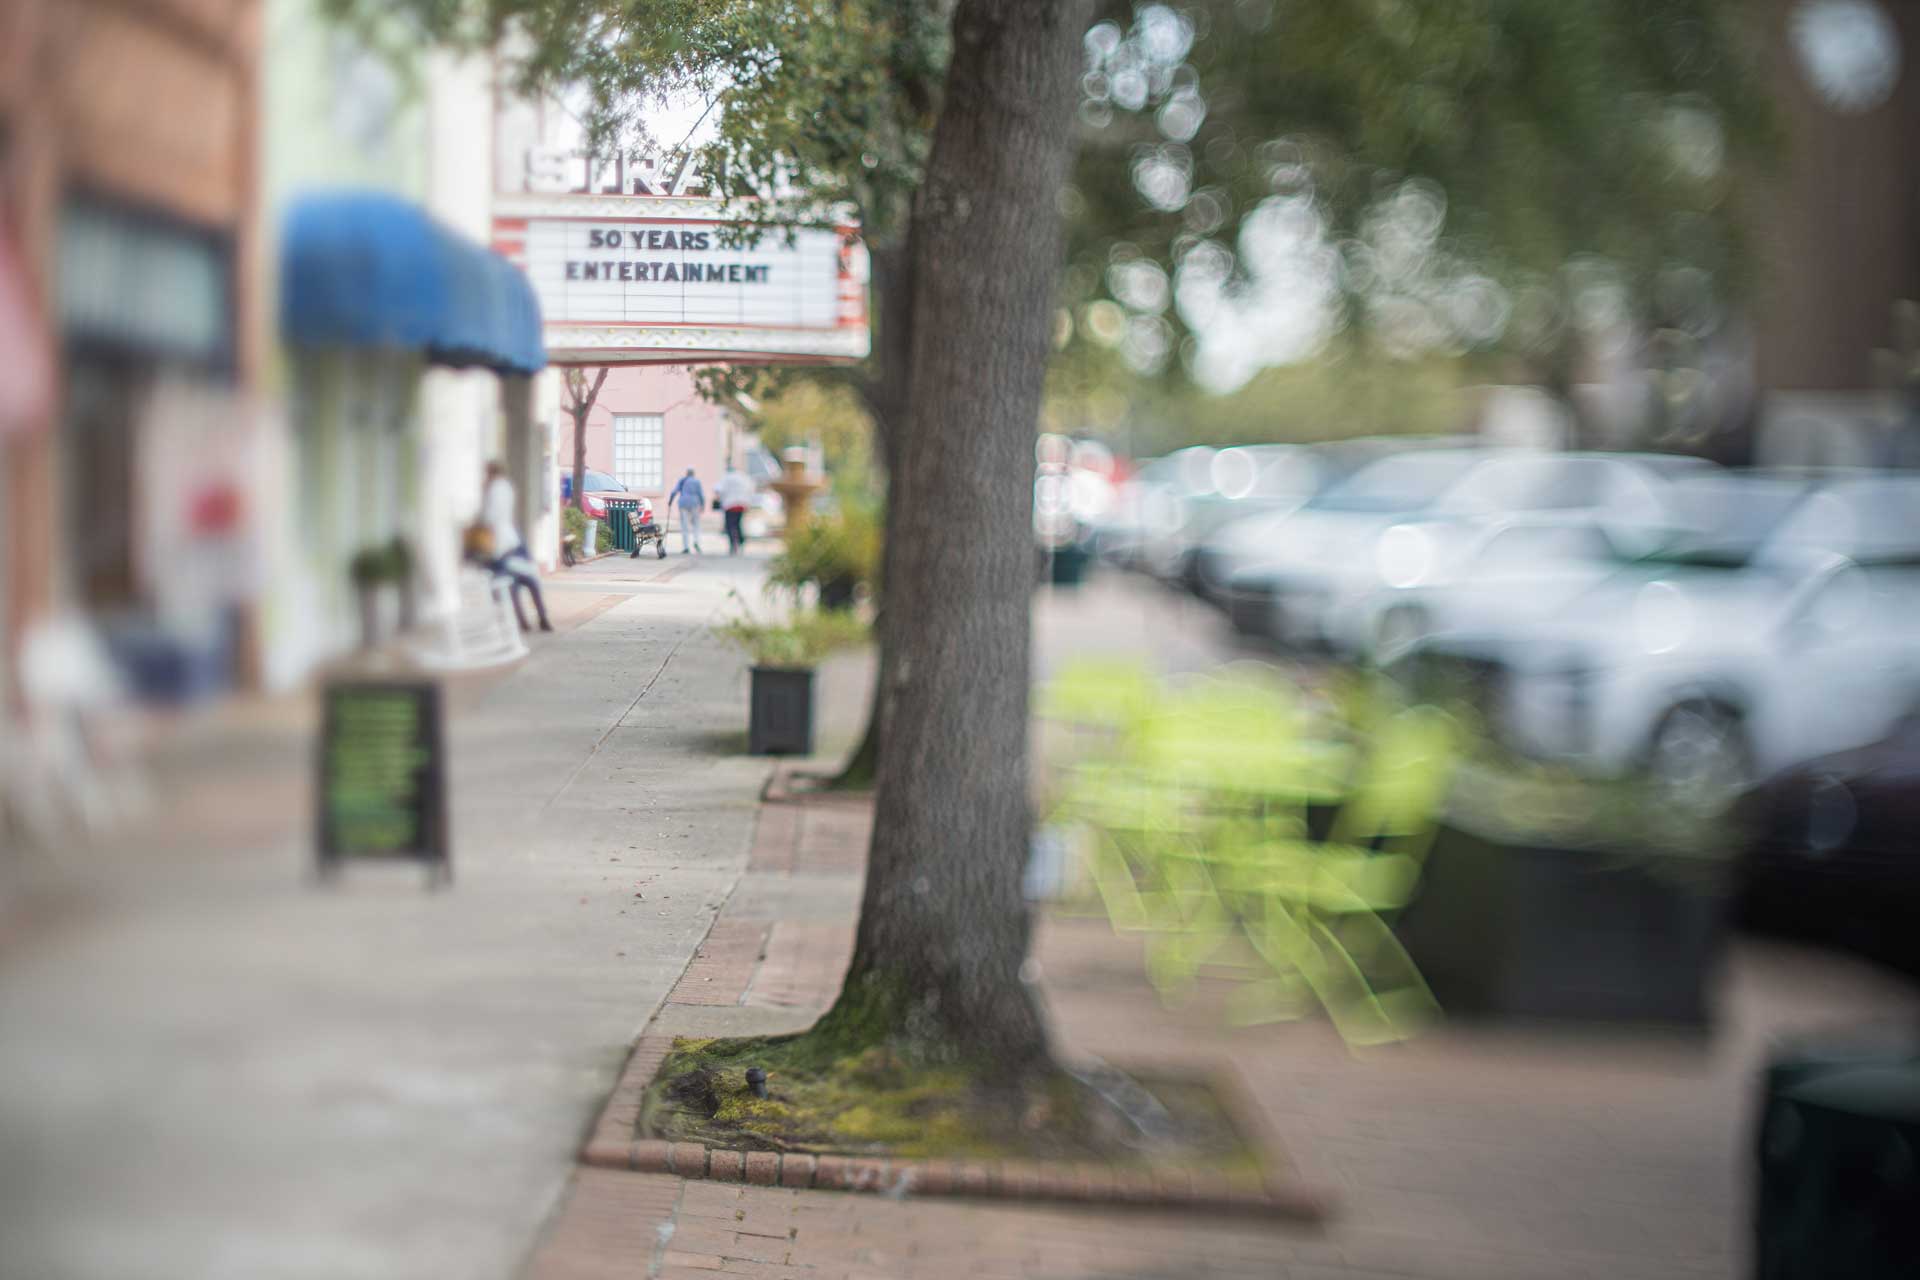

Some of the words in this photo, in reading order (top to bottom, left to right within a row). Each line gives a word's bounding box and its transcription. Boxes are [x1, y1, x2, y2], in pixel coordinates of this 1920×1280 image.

[589, 229, 622, 249] 50
[631, 230, 709, 250] YEARS
[565, 261, 769, 283] ENTERTAINMENT
